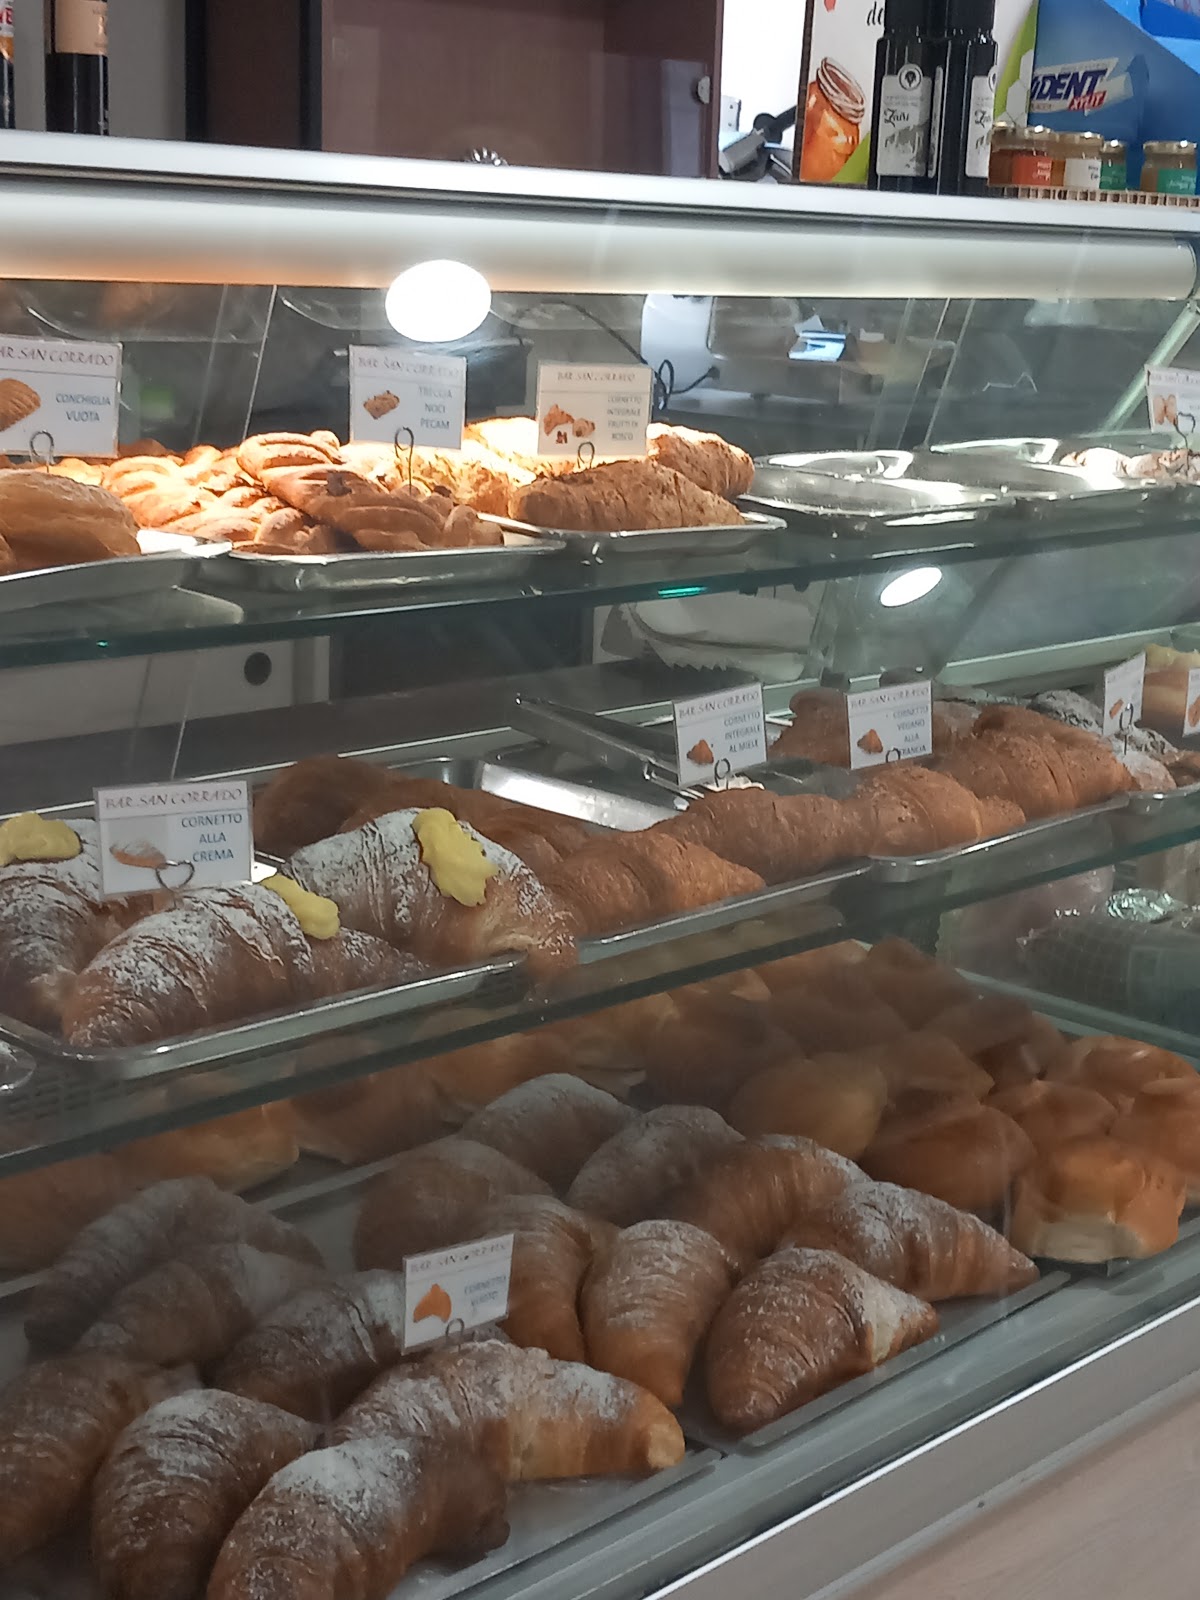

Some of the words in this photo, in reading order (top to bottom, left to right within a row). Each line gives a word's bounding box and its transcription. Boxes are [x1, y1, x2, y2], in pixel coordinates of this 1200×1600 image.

[18, 348, 47, 361] SAN
[49, 350, 114, 366] CORRADO
[56, 393, 111, 406] CONCHIGLIA
[425, 402, 446, 413] NOCI
[66, 410, 100, 422] VUOTA
[724, 711, 761, 727] CORNETTO
[105, 798, 131, 809] BAR
[138, 793, 168, 806] SAN
[171, 788, 242, 804] CORRADO
[181, 813, 242, 828] CORNETTO
[199, 832, 227, 844] ALLA
[192, 849, 234, 863] CREMA
